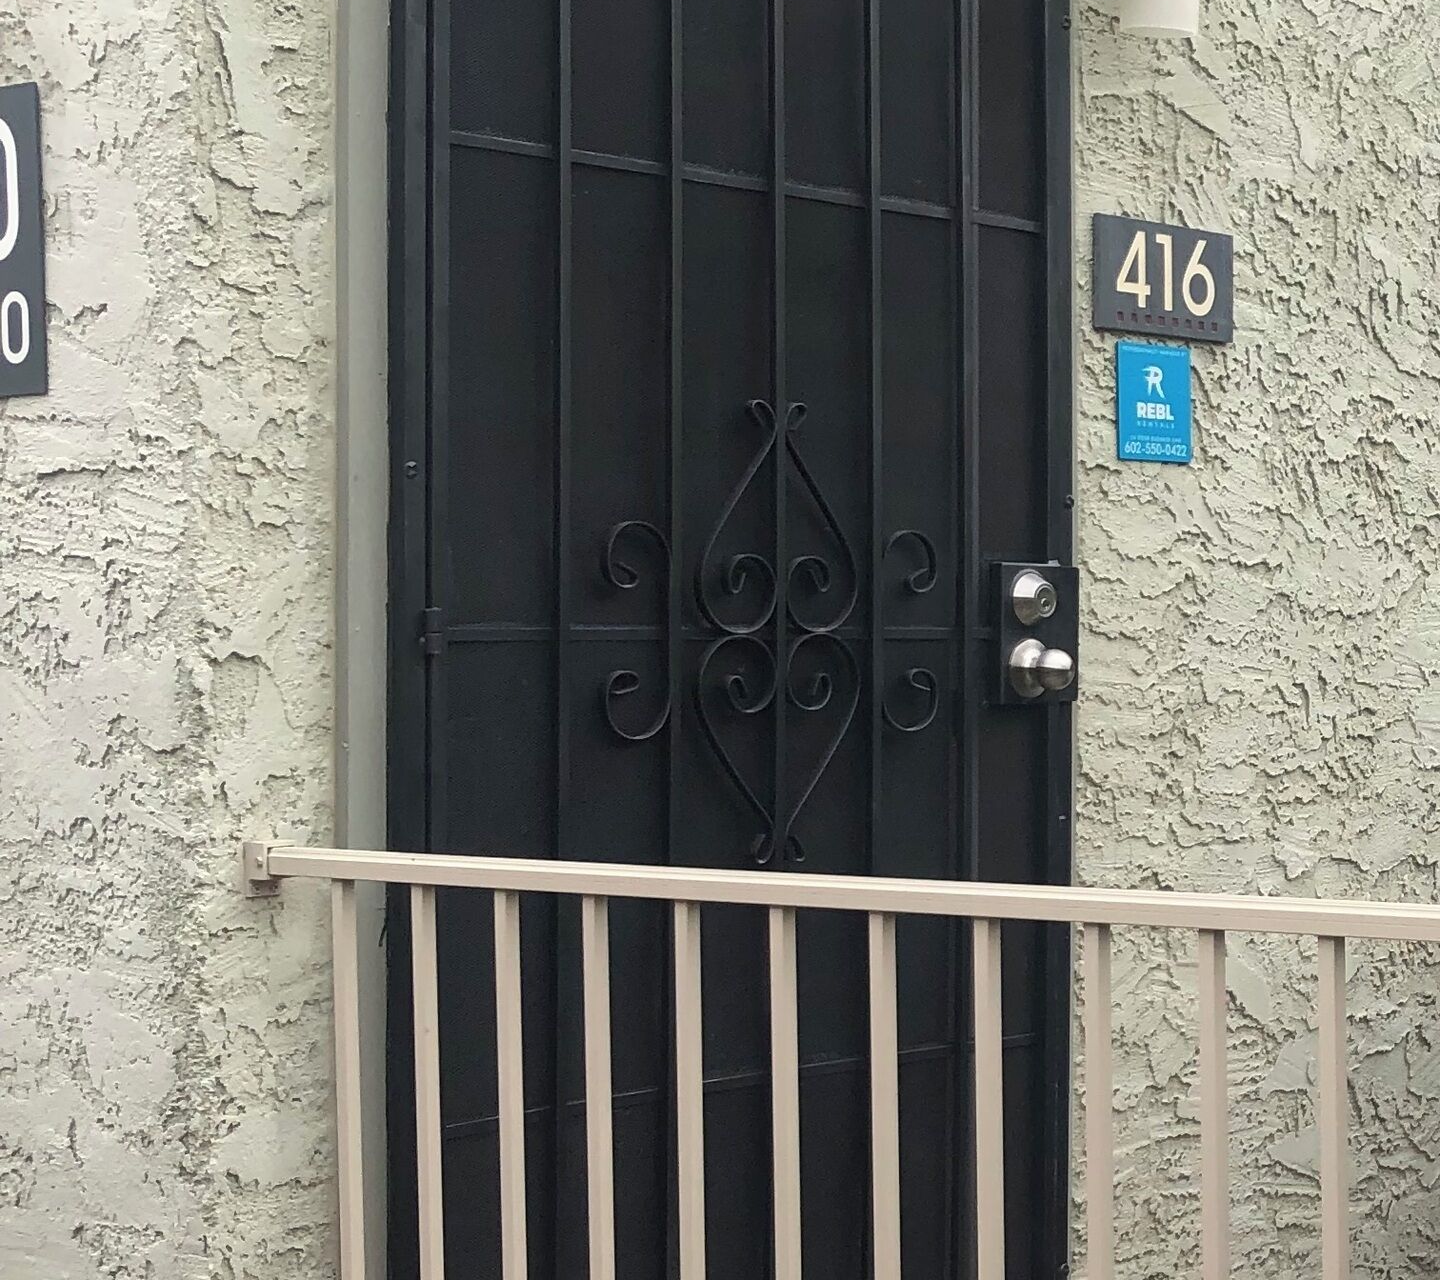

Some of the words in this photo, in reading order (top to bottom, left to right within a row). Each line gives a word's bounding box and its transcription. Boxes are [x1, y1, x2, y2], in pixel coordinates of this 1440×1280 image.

[1116, 230, 1215, 317] 416
[1141, 366, 1165, 399] R
[1136, 401, 1175, 421] REBL
[1124, 440, 1188, 457] 602-550-0422
